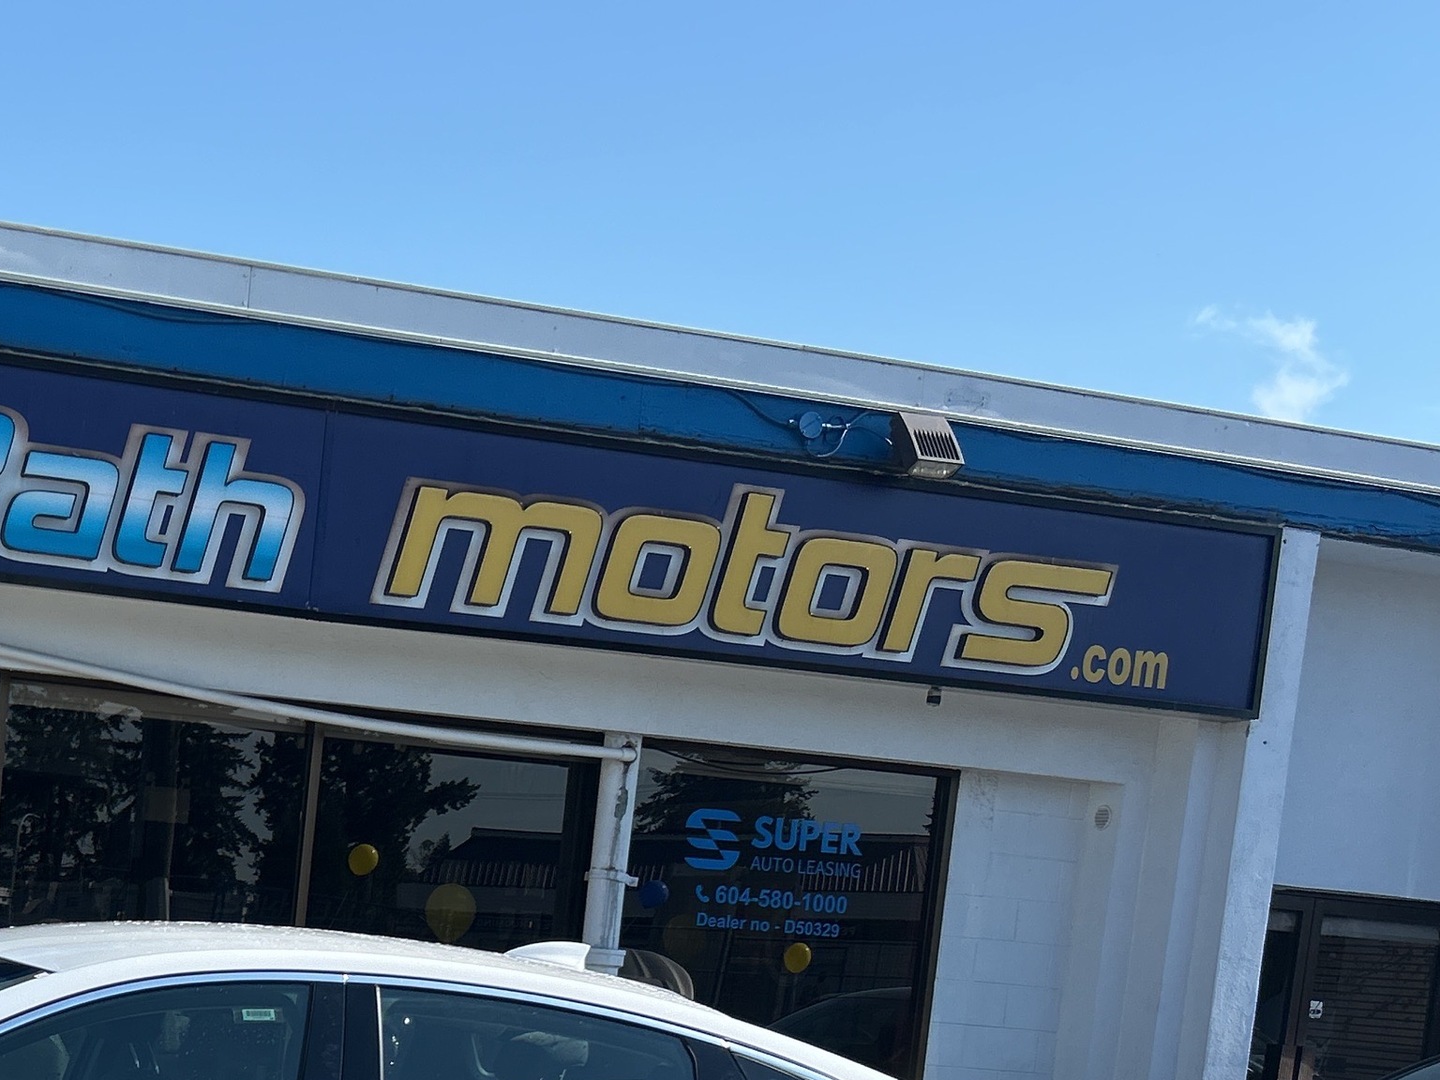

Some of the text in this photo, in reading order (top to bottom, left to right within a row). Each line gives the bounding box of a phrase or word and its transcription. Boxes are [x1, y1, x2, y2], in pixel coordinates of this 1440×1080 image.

[372, 476, 1118, 676] motors
[1071, 645, 1168, 689] .com
[751, 816, 862, 856] SUPER
[750, 855, 861, 878] AUTO LEASING
[715, 885, 848, 914] 604-580-1000
[696, 912, 746, 930] Dealer
[750, 920, 770, 932] no
[784, 920, 840, 938] D50329
